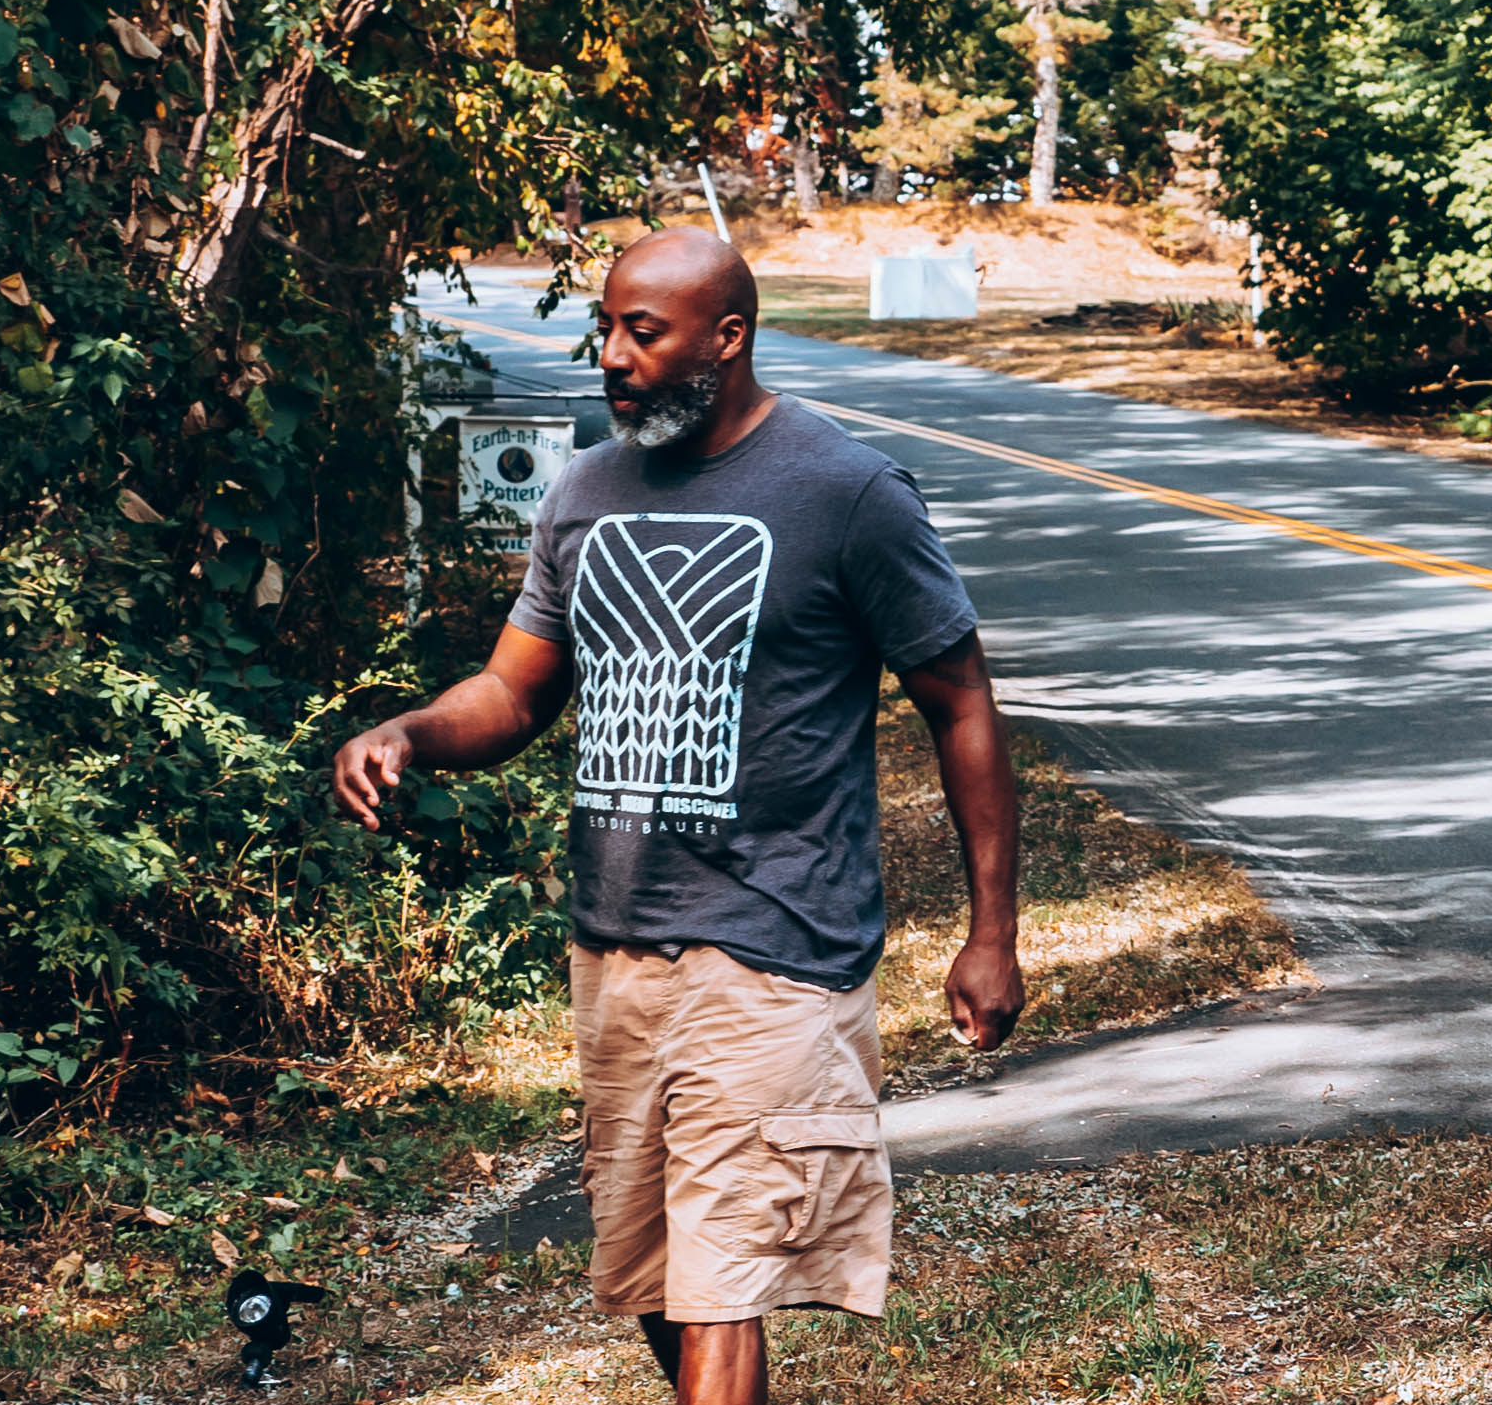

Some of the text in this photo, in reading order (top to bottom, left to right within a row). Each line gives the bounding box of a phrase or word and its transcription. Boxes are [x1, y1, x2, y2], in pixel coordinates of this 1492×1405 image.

[472, 427, 561, 455] Earth-n-Fire
[589, 815, 718, 836] EDDIE BAUER
